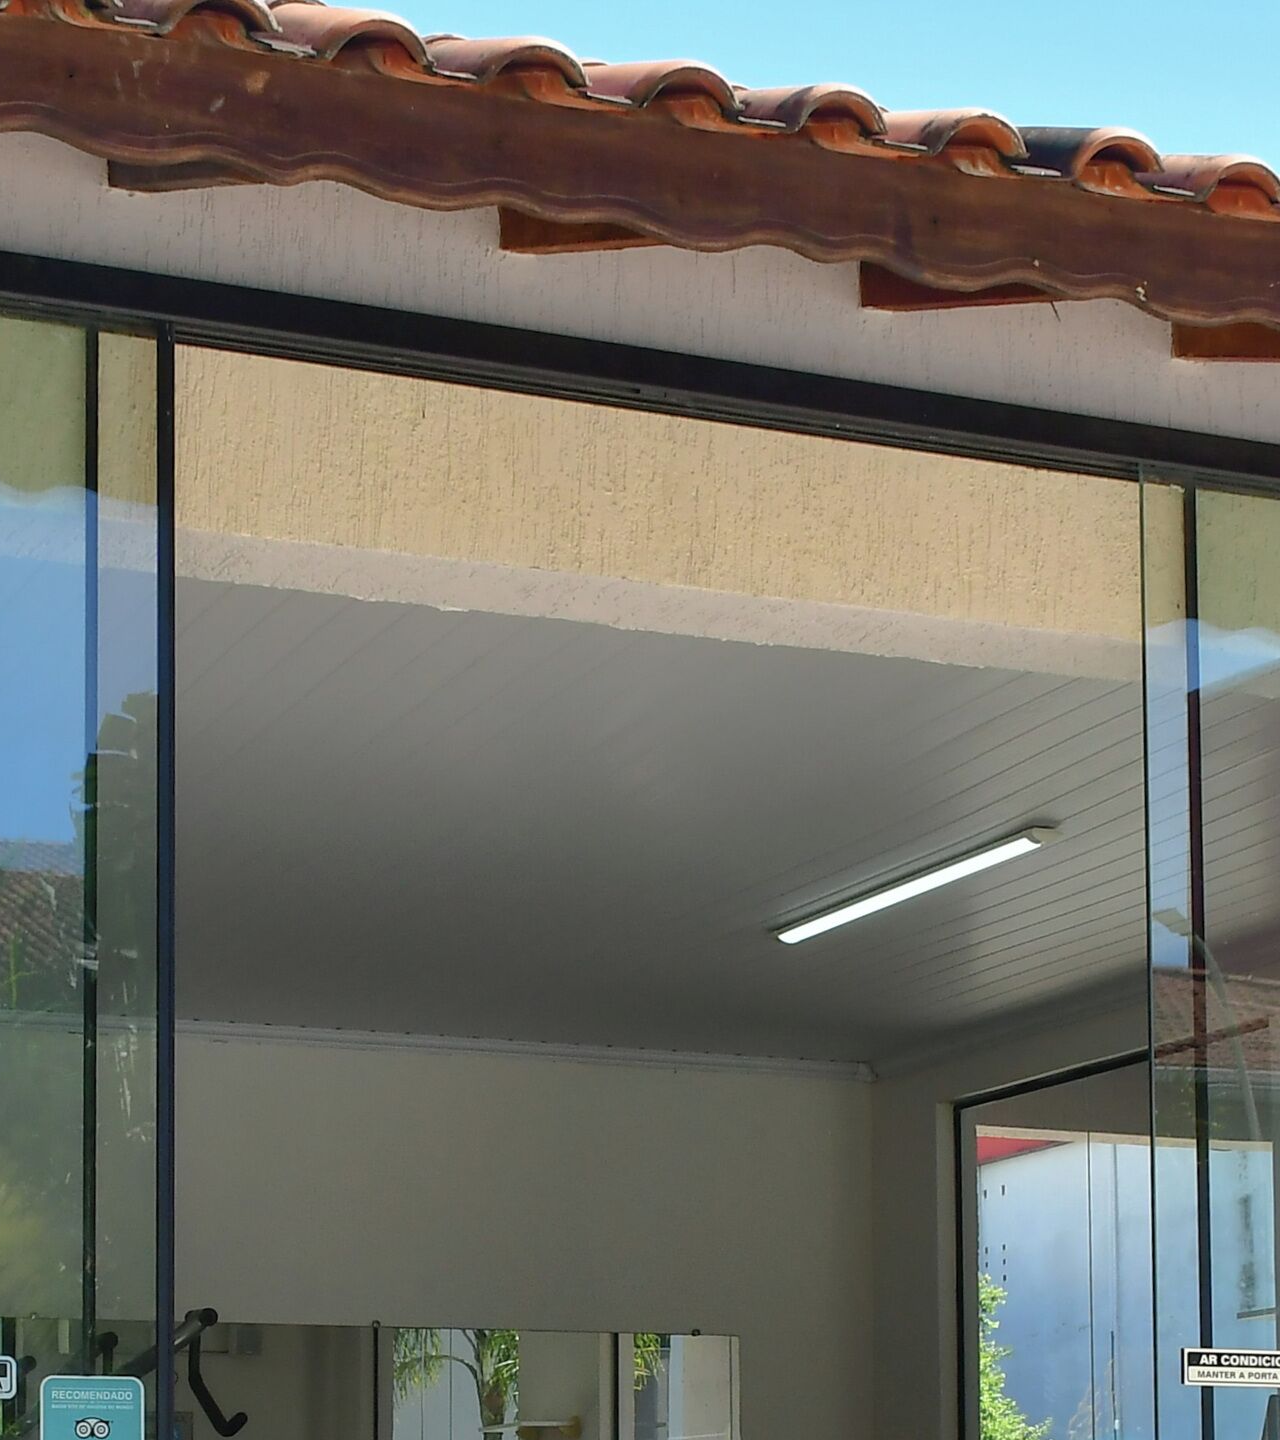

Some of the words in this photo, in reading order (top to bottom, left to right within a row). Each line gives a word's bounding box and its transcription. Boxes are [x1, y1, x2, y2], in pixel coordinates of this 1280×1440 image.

[1199, 1354, 1218, 1365] AR
[1197, 1370, 1236, 1379] MANTER
[1238, 1371, 1245, 1379] A
[1248, 1371, 1278, 1380] PORTA
[51, 1390, 133, 1401] RECOMENDADO
